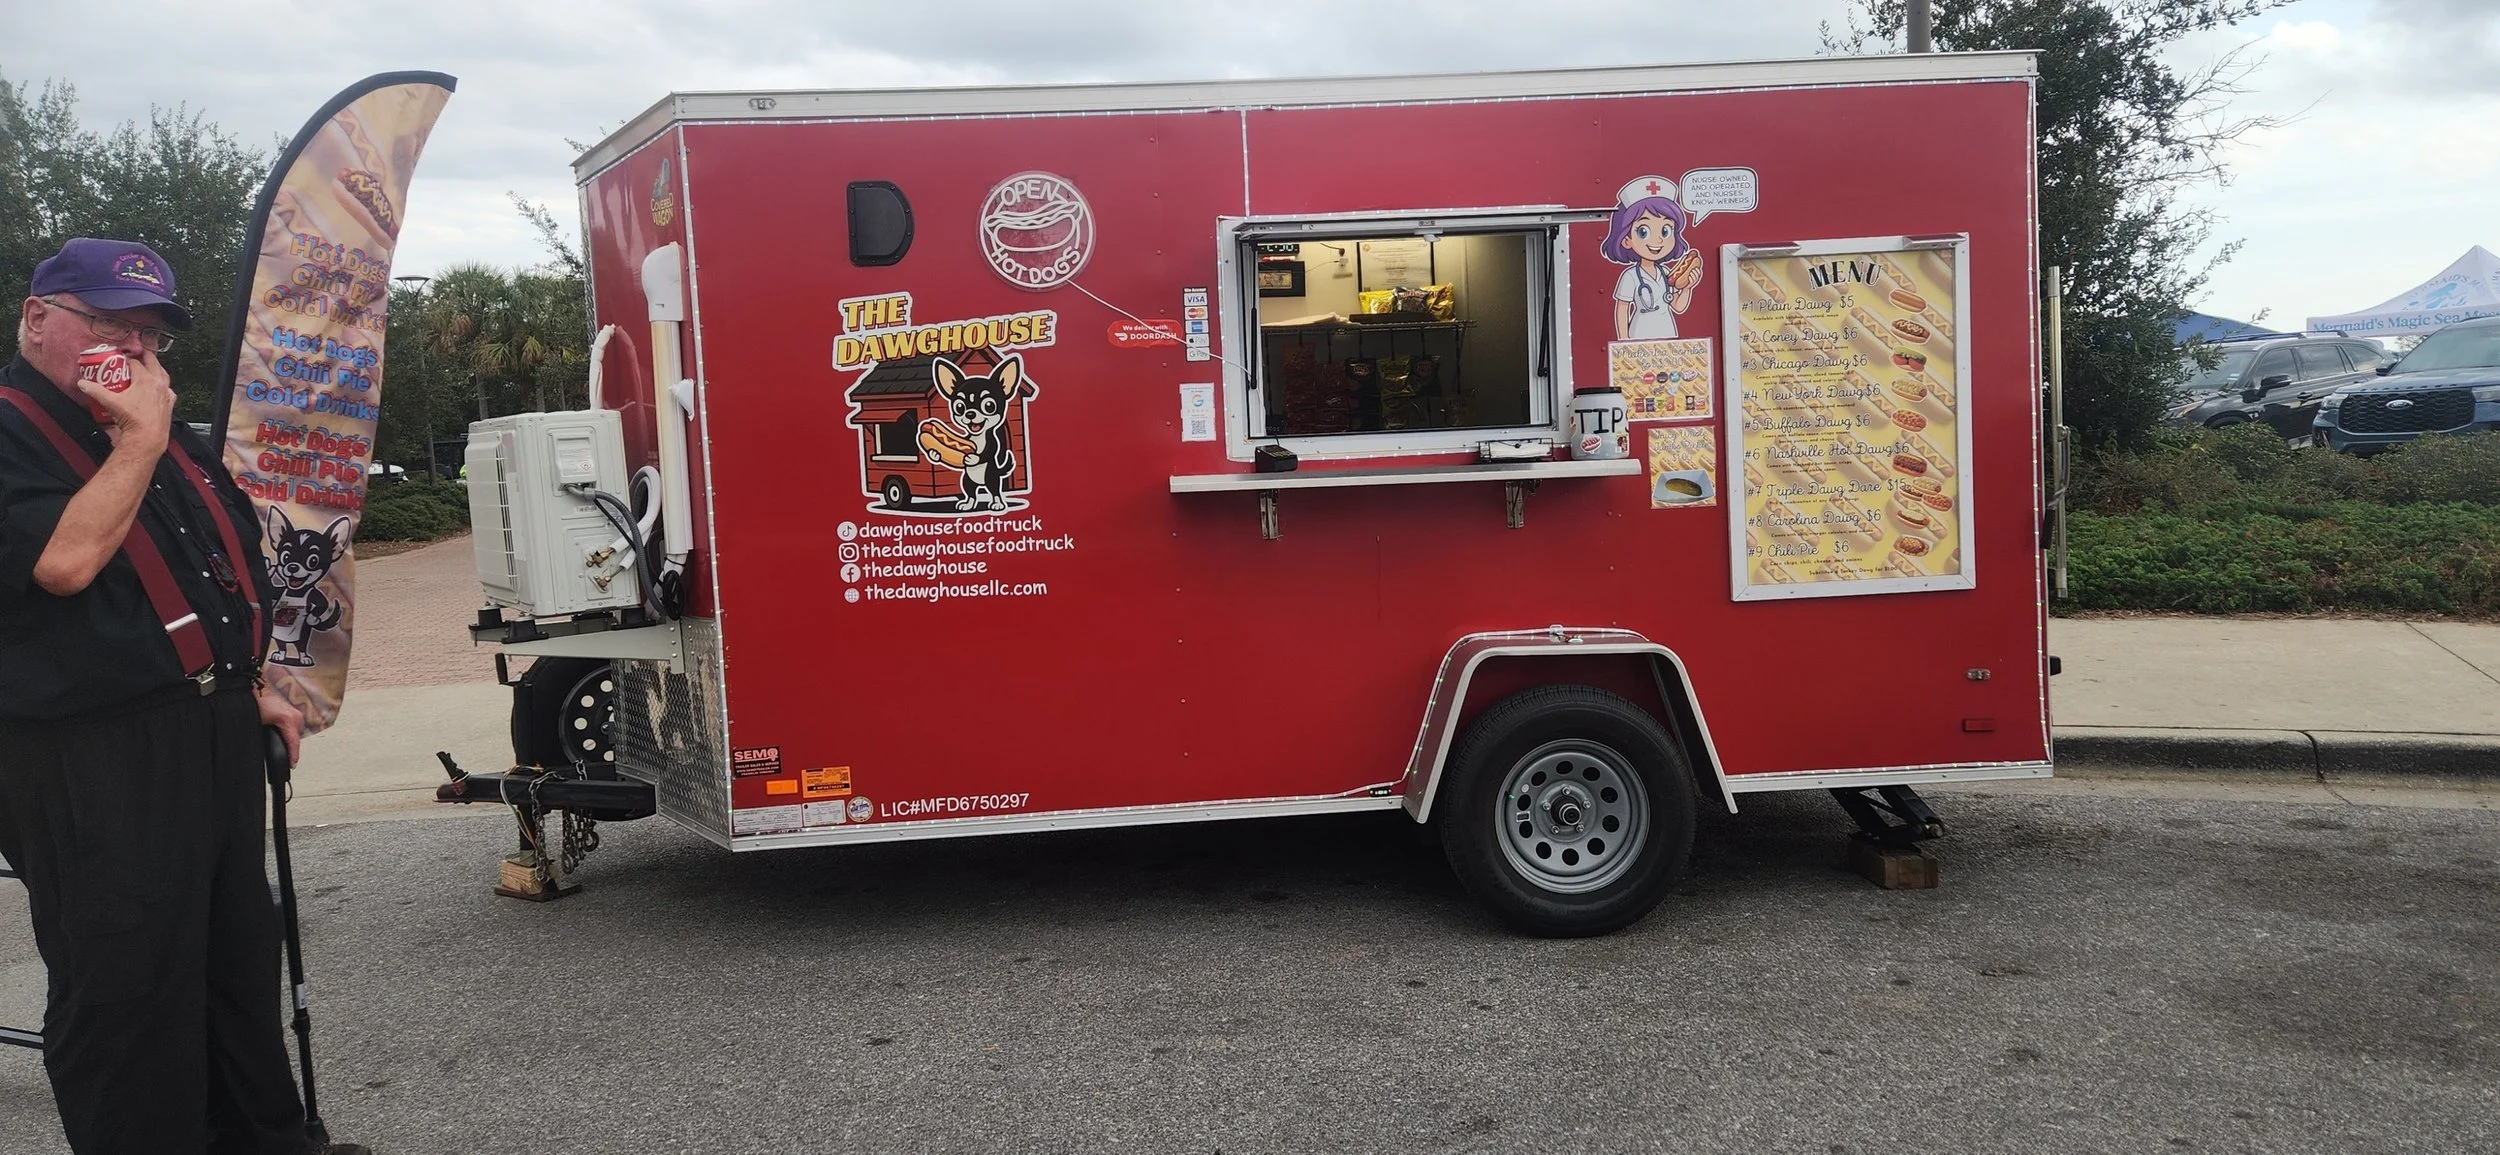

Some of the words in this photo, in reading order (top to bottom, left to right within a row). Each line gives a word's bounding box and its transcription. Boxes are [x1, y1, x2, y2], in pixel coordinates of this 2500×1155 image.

[996, 179, 1064, 210] OPEN
[289, 234, 345, 266] Hot
[344, 248, 389, 283] Dogs
[991, 246, 1027, 281] HOT
[1029, 246, 1081, 284] DOGS
[292, 263, 353, 296] Chili
[1807, 260, 1884, 290] MENU
[264, 285, 328, 318] Cold
[1187, 295, 1206, 303] VISA
[1741, 301, 1754, 312] #1
[1758, 299, 1792, 312] Plain
[1795, 297, 1832, 313] Dawg
[1839, 295, 1855, 308] $5
[843, 296, 908, 331] THE
[2312, 318, 2384, 333] Mermaid's
[2388, 315, 2430, 330] Magic
[2434, 313, 2461, 325] Sea
[272, 325, 322, 354] Hot
[325, 337, 377, 368] Dogs
[836, 313, 1053, 367] DAWGHOUSE
[1130, 332, 1177, 340] DOORDASH
[1742, 331, 1757, 344] #2
[1762, 329, 1800, 345] Coney
[1801, 328, 1840, 344] Dawg
[1842, 326, 1858, 340] $6
[274, 355, 331, 384] Chili
[337, 367, 371, 392] Pie
[1742, 359, 1757, 370] #3
[1761, 357, 1810, 372] Chicago
[1812, 354, 1851, 370] Dawg
[1852, 354, 1868, 367] $6
[246, 379, 310, 410] Cold
[315, 391, 380, 421] Drinks
[1743, 390, 1758, 401] #4
[1762, 388, 1793, 401] New
[1793, 386, 1824, 400] York
[1826, 385, 1866, 400] Dawg
[1864, 383, 1881, 398] $6
[1744, 419, 1760, 431] #5
[1763, 417, 1812, 433] Buffalo
[1814, 415, 1852, 430] Dawg
[1855, 414, 1871, 427] $6
[256, 418, 308, 448] Hot
[306, 426, 371, 459] Dogs
[1745, 448, 1760, 460] #6
[1764, 444, 1825, 460] Nashville
[1828, 442, 1854, 456] Hot
[1855, 442, 1894, 458] Dawg
[1893, 442, 1910, 455] $6
[257, 448, 319, 477] Chili
[319, 455, 364, 484] Pie
[1747, 485, 1762, 497] #7
[1766, 482, 1805, 500] Triple
[1808, 481, 1846, 498] Dawg
[1848, 480, 1882, 494] Dare
[1886, 478, 1908, 491] $15
[859, 515, 1043, 541] dawghousefoodtruck
[1748, 516, 1763, 527] #8
[1767, 513, 1820, 527] Carolina
[1823, 510, 1862, 525] Dawg
[1866, 509, 1882, 522] $6
[861, 533, 1075, 560] thedawghousefoodtruck
[1748, 546, 1763, 557] #9
[1767, 544, 1797, 557] Chili
[1798, 542, 1820, 555] Pie
[1834, 540, 1850, 553] $6
[862, 559, 988, 580] thedawghouse
[864, 579, 1048, 602] thedawghousellc.com
[880, 792, 1030, 817] LIC#MFD6750297
